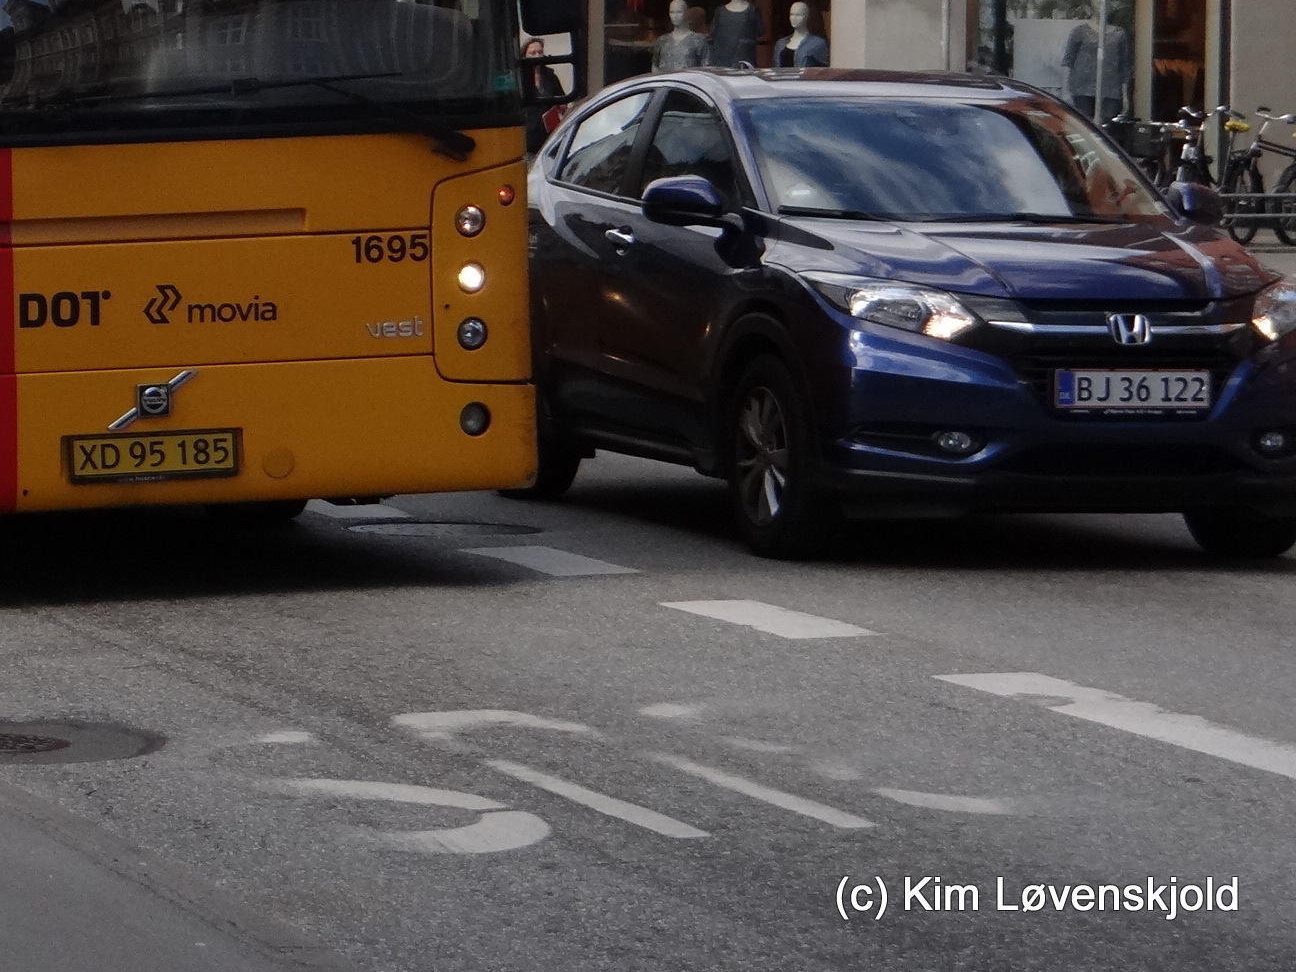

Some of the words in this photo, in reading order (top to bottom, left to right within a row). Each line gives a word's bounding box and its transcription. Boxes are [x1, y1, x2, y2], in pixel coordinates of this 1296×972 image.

[351, 235, 429, 263] 1695
[187, 295, 278, 323] movia
[366, 315, 424, 338] vest
[1077, 377, 1111, 402] BJ
[1119, 377, 1151, 402] 36
[1161, 377, 1206, 402] 122
[79, 443, 121, 471] XD
[129, 440, 166, 468] 95
[177, 438, 229, 465] 185
